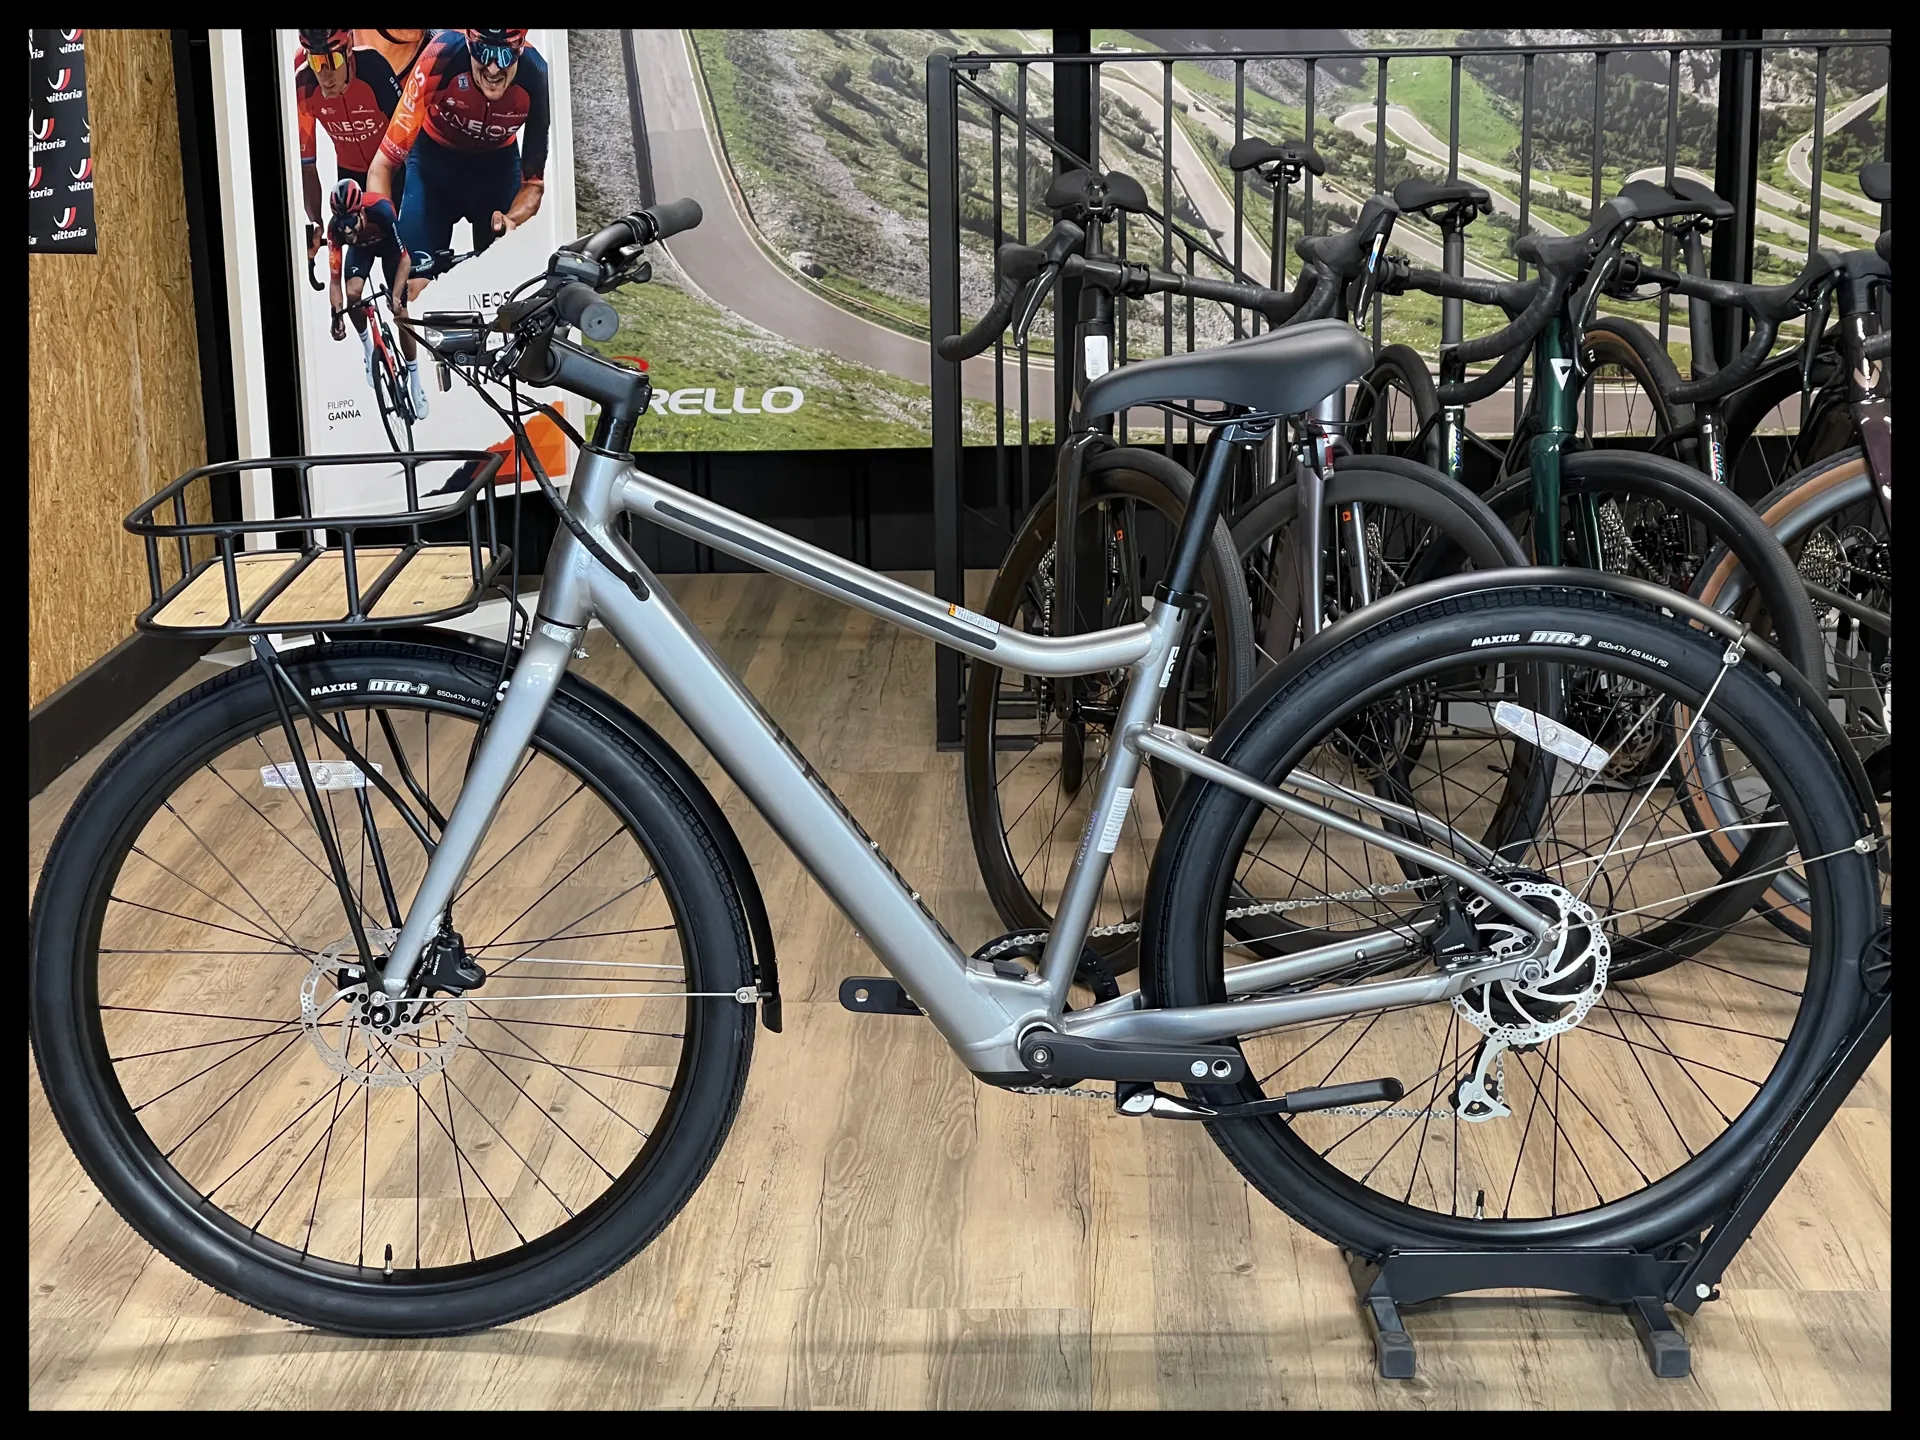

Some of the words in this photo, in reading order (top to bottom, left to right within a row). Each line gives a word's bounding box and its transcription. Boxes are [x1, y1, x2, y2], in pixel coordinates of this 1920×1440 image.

[46, 89, 82, 103] vittoria
[327, 118, 375, 131] INEOS
[29, 187, 54, 199] toria
[51, 227, 87, 241] vittoria
[327, 399, 354, 410] FILIPPO
[649, 386, 804, 415] RELLO
[327, 409, 361, 421] GANNA
[1470, 633, 1520, 647] MAXXIS
[1528, 630, 1592, 647] DTR-1
[1631, 649, 1641, 657] 65
[1641, 652, 1658, 663] MAX
[1657, 658, 1669, 668] PSI
[310, 682, 358, 697] MAXXIS
[367, 678, 430, 696] DTR-1
